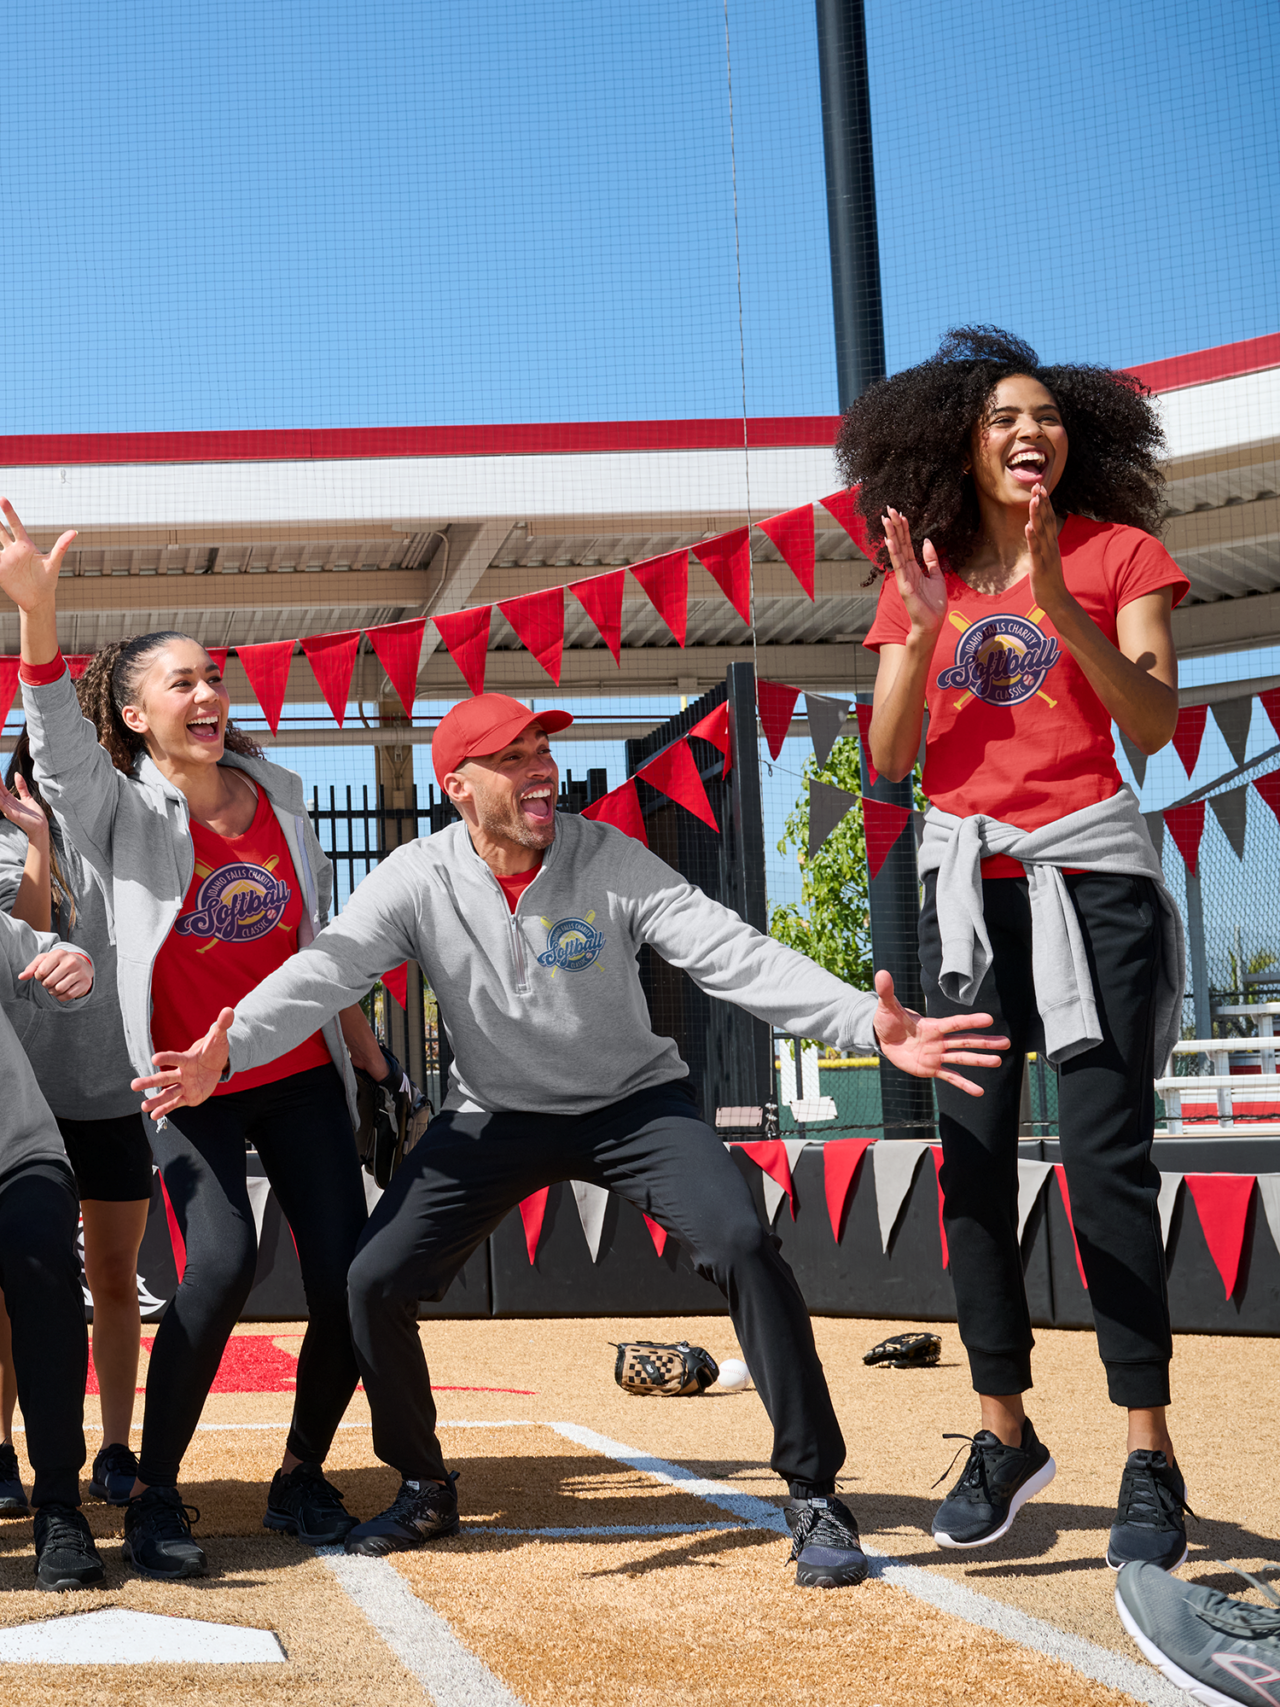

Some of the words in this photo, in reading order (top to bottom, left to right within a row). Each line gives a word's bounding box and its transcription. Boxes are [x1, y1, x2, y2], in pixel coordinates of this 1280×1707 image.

[965, 631, 983, 653] IDAHO
[983, 622, 1006, 636] FALLS
[1008, 623, 1038, 645] CHARITY
[936, 636, 1063, 697] Softball
[995, 683, 1025, 700] CLASSIC
[207, 877, 227, 897] IDAHO
[226, 869, 247, 880] FALLS
[248, 870, 274, 888] CHARITY
[174, 880, 291, 941] Softball
[242, 919, 269, 938] CLASSIC
[537, 931, 607, 968] Softball
